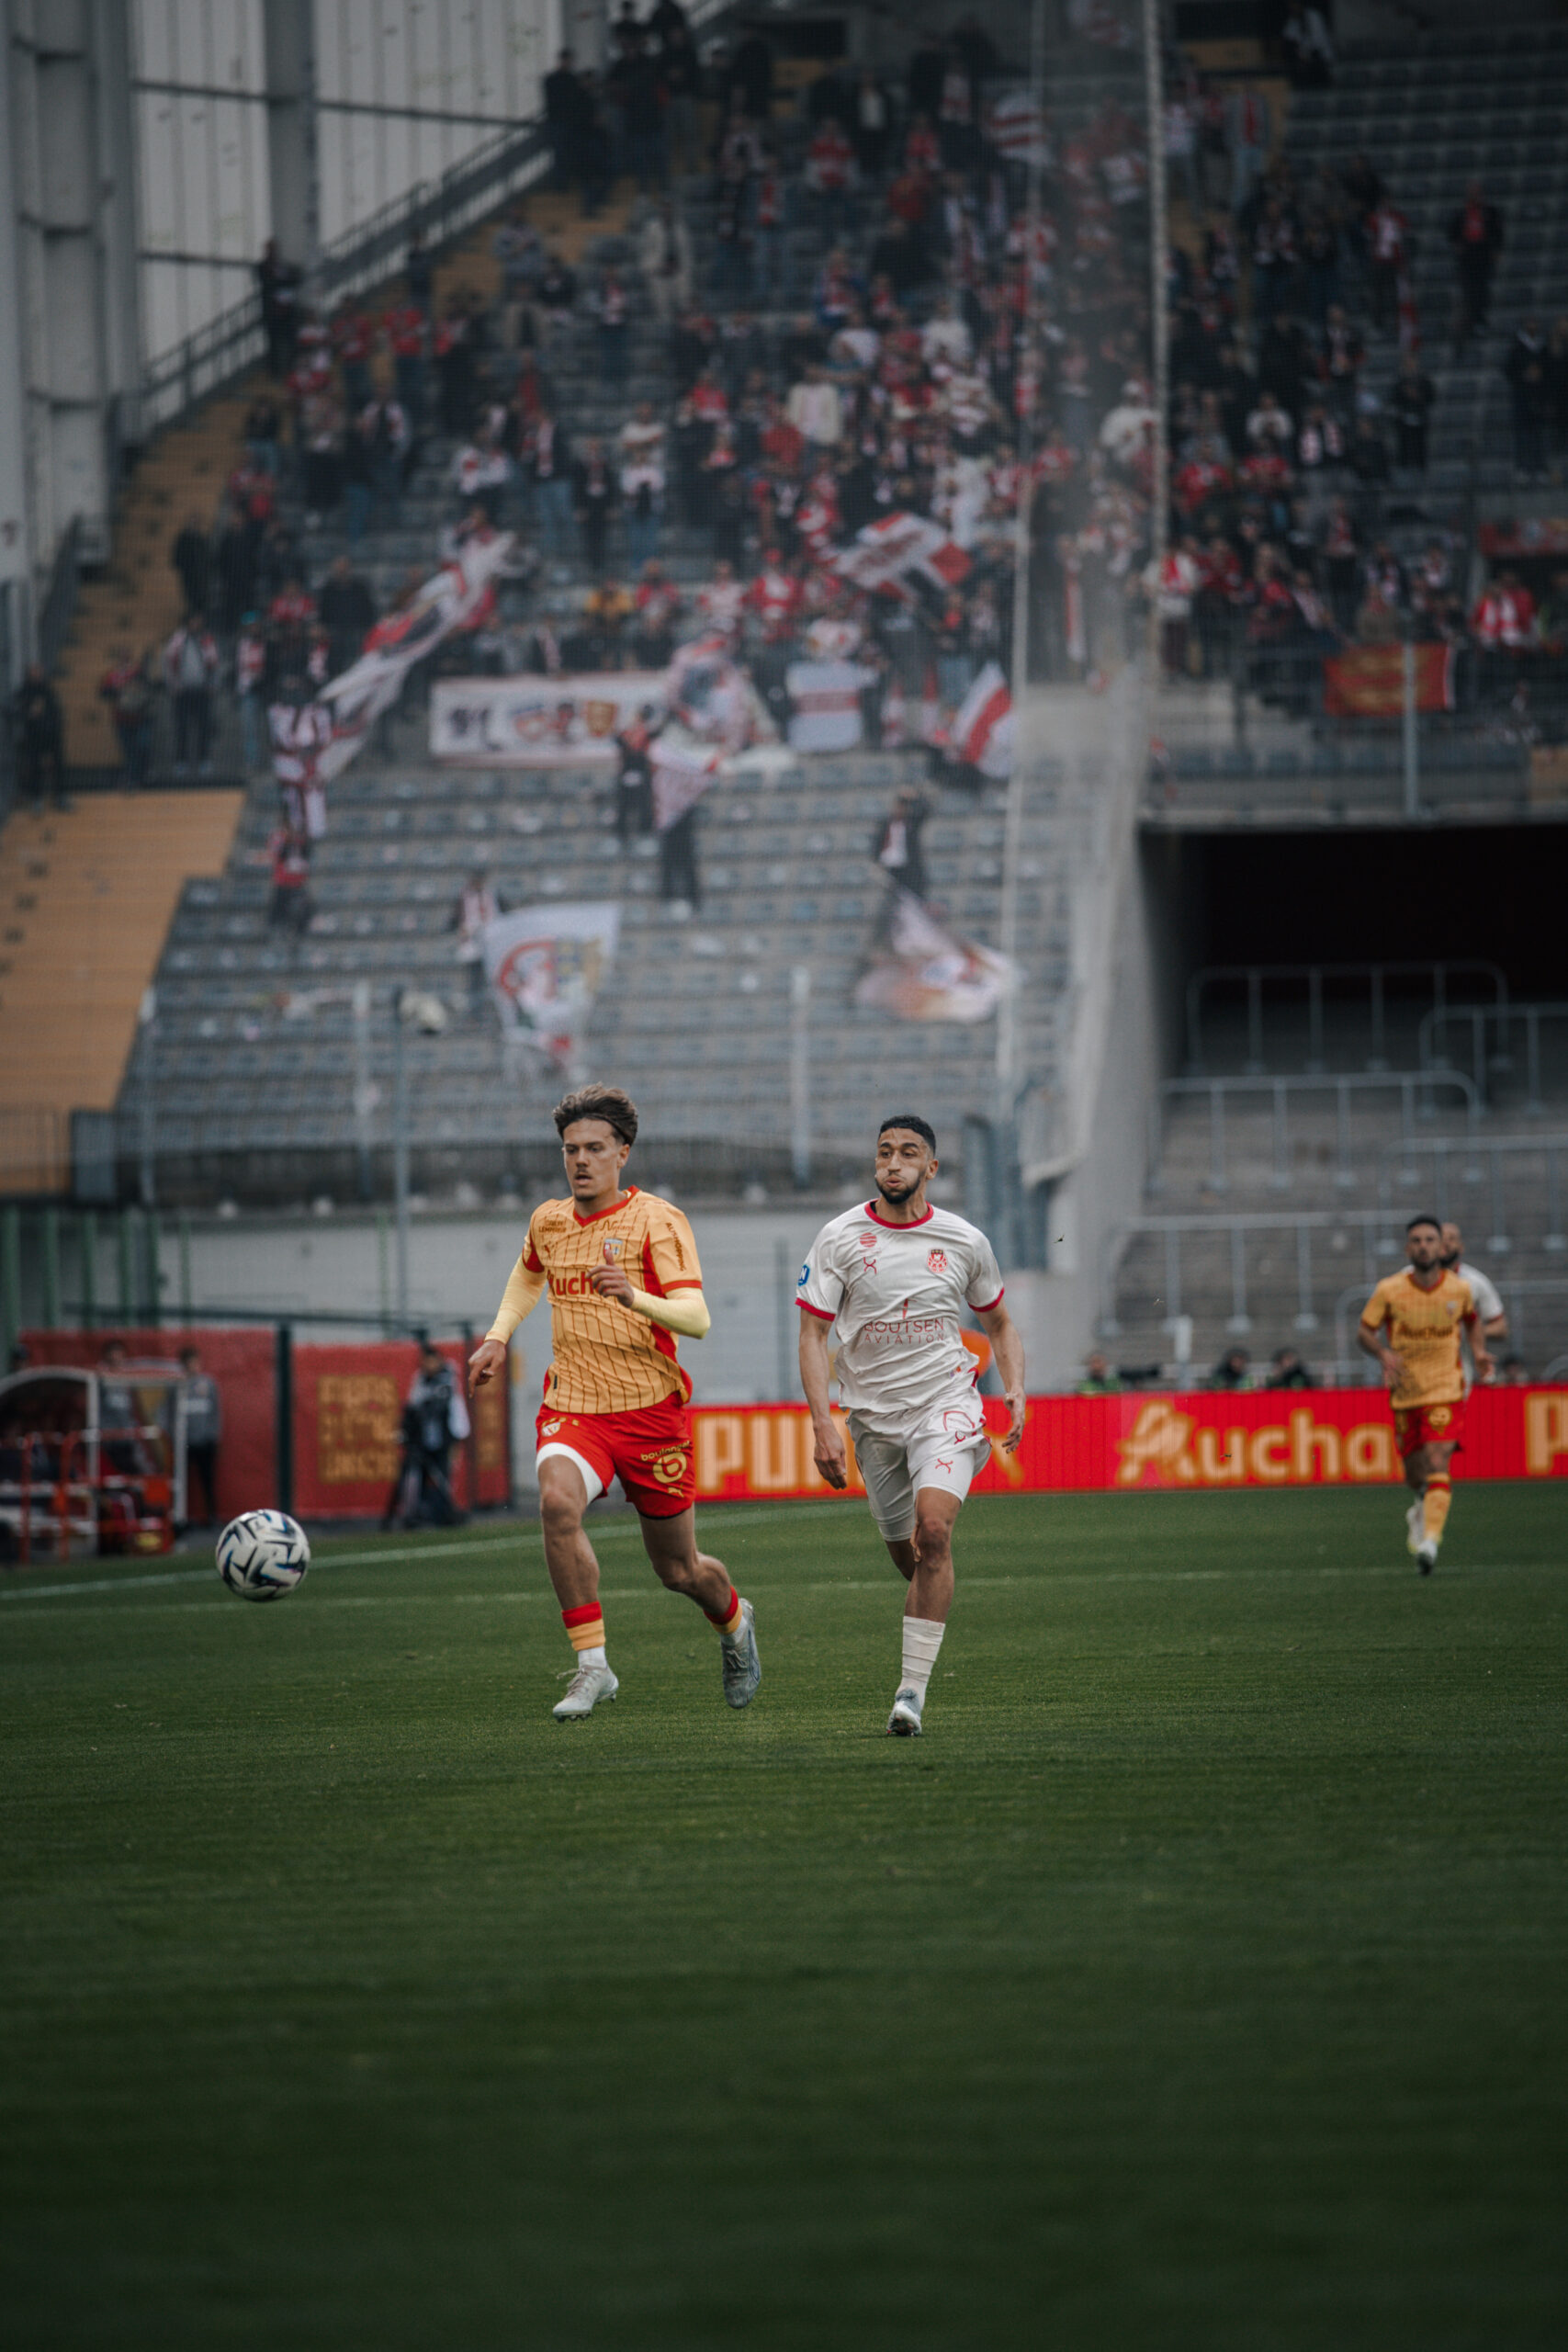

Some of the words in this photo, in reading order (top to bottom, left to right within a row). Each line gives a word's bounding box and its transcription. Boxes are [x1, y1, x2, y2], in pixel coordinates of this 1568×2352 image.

[863, 1317, 944, 1333] BOUTSEN
[864, 1333, 944, 1345] AVIATION
[1116, 1399, 1402, 1484] Aucha
